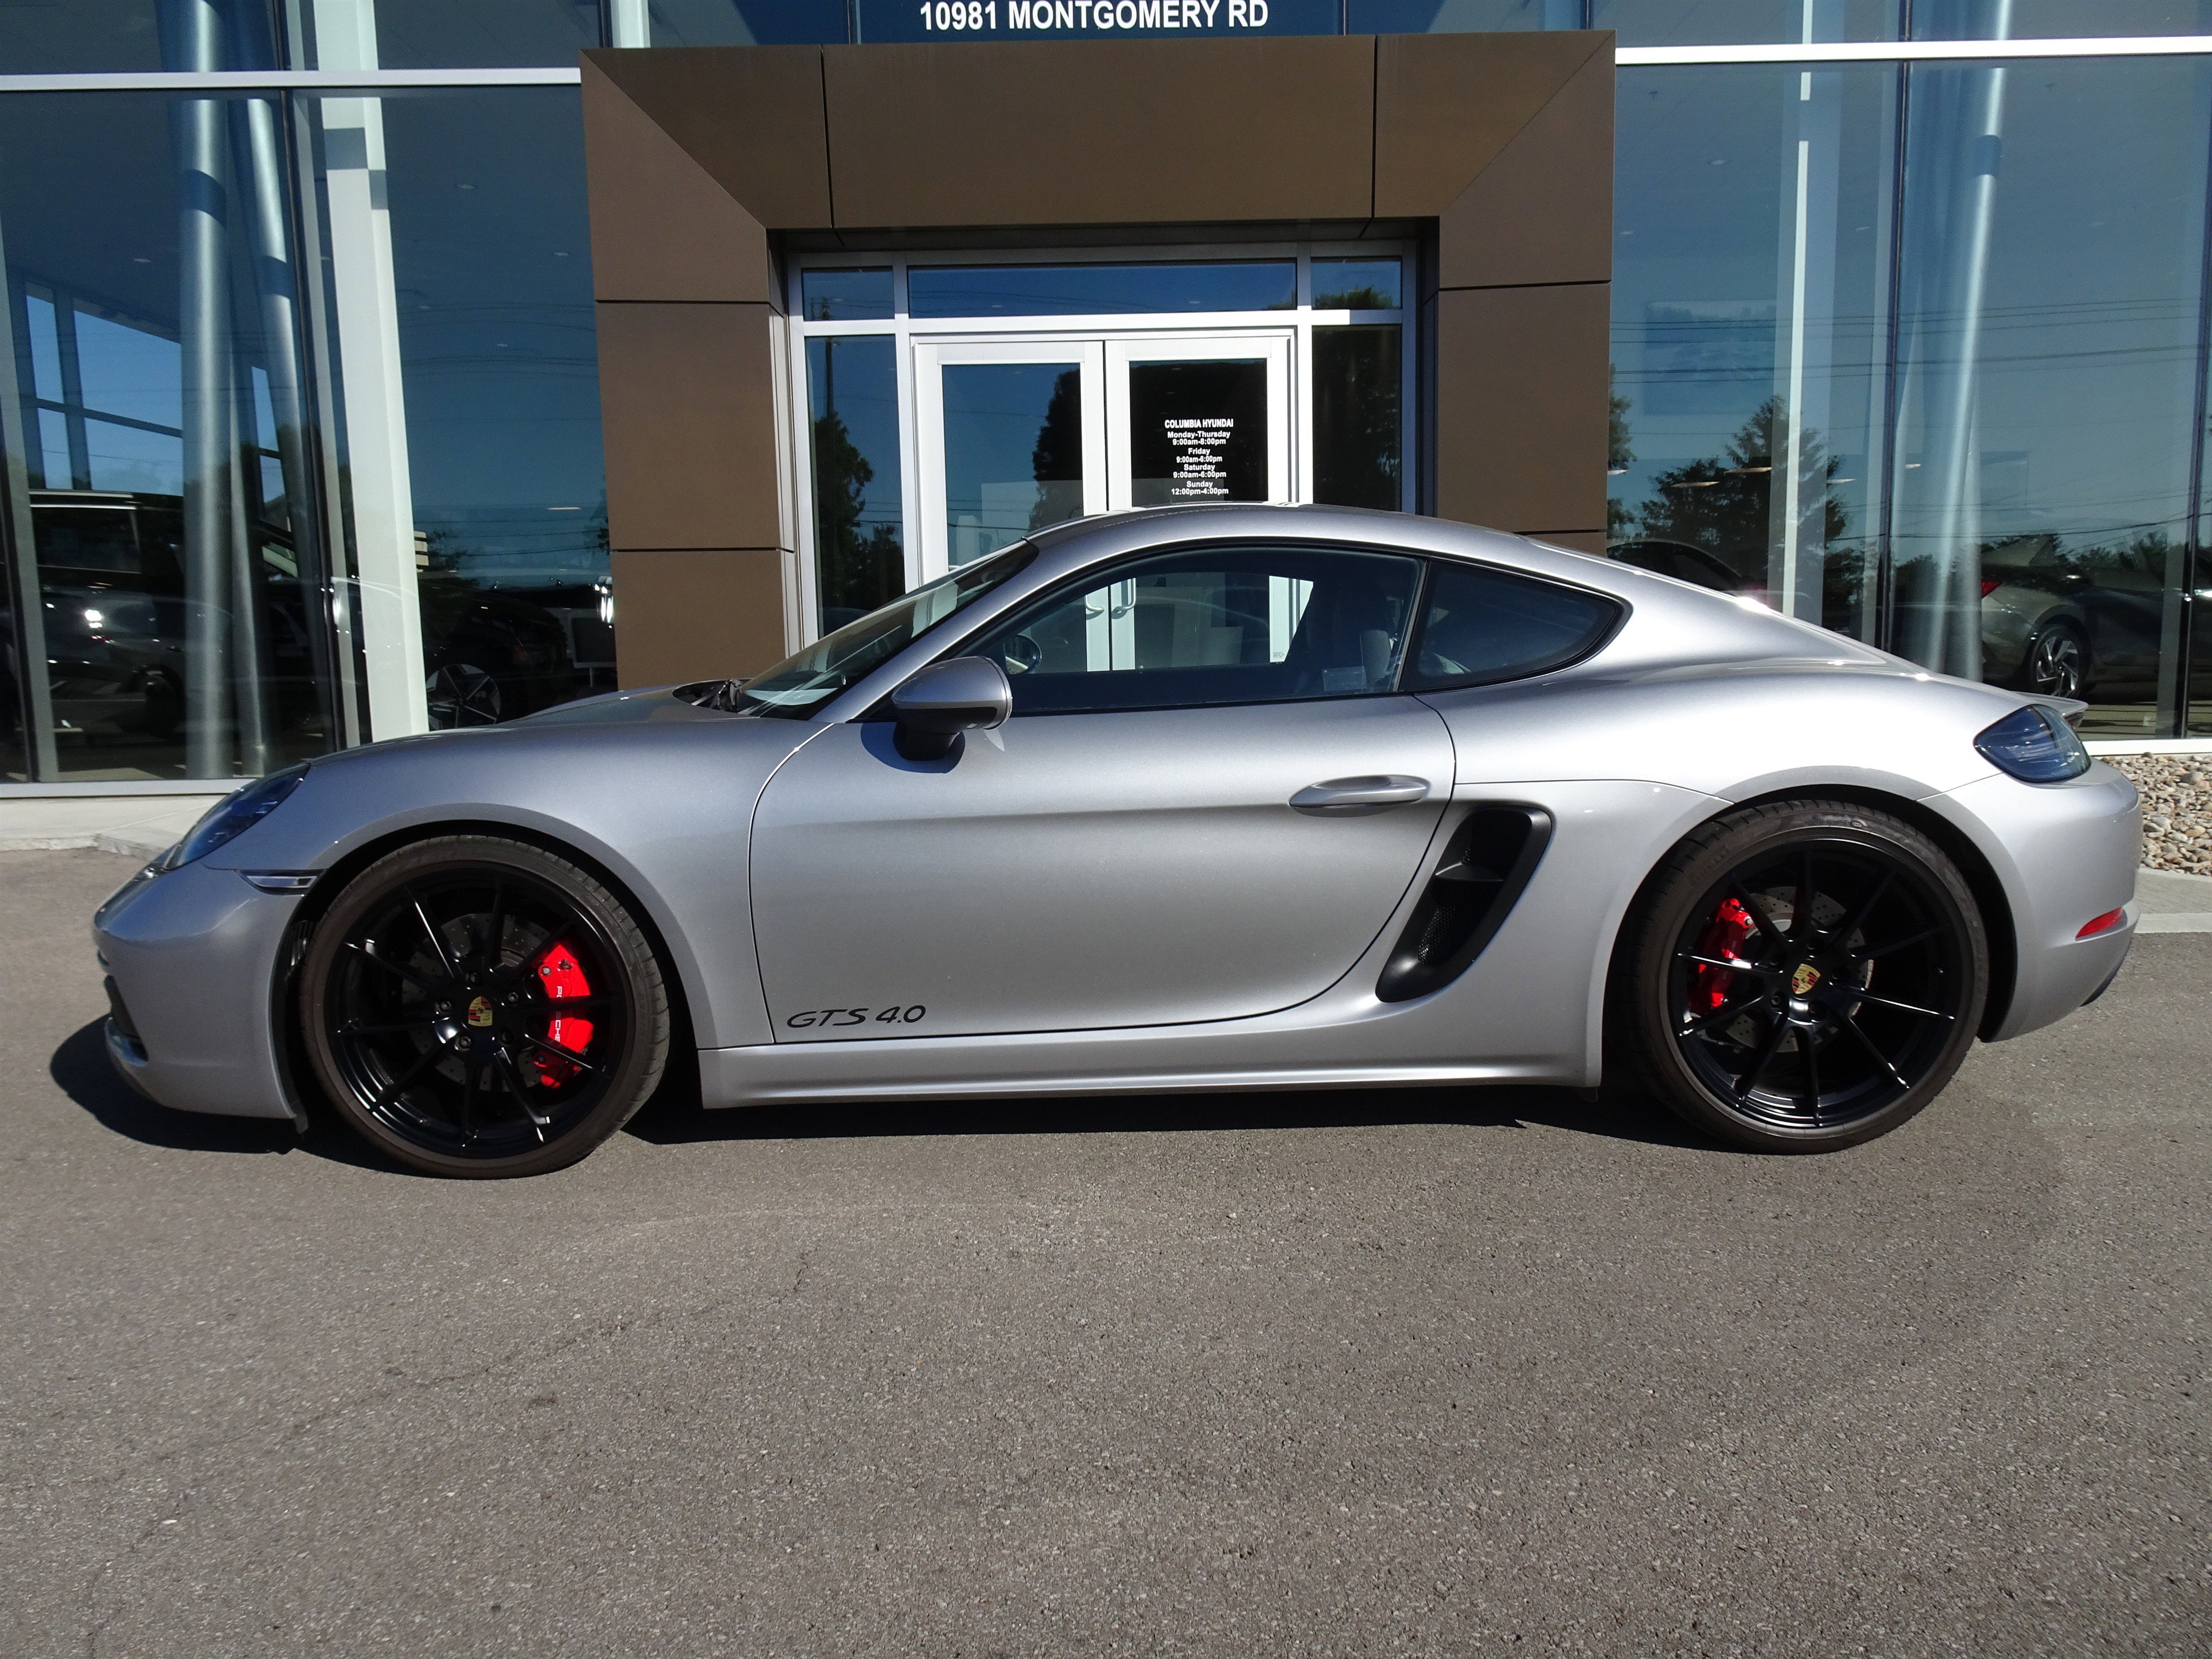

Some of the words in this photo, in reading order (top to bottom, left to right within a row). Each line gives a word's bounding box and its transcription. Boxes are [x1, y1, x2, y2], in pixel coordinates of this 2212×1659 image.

[920, 1, 996, 30] 10981
[1008, 0, 1219, 29] MONTGOMERY
[1229, 0, 1269, 27] RD
[1164, 419, 1202, 429] COLUMBIA
[1202, 418, 1234, 428] HYUNDAI
[1167, 430, 1231, 439] Monday-Thursday
[1172, 438, 1226, 446] 9:00am-8:00pm
[1188, 447, 1211, 455] Friday
[1176, 455, 1223, 464] 9:00am-6:00pm
[1183, 463, 1216, 471] Saturday
[1173, 470, 1227, 479] 9:00am-6:00pm
[1186, 480, 1213, 488] Sunday
[1171, 487, 1229, 496] 12:00pm-4:00pm
[555, 986, 563, 1042] PSCHE
[786, 1008, 869, 1028] GTS
[875, 1004, 926, 1024] 4.0
